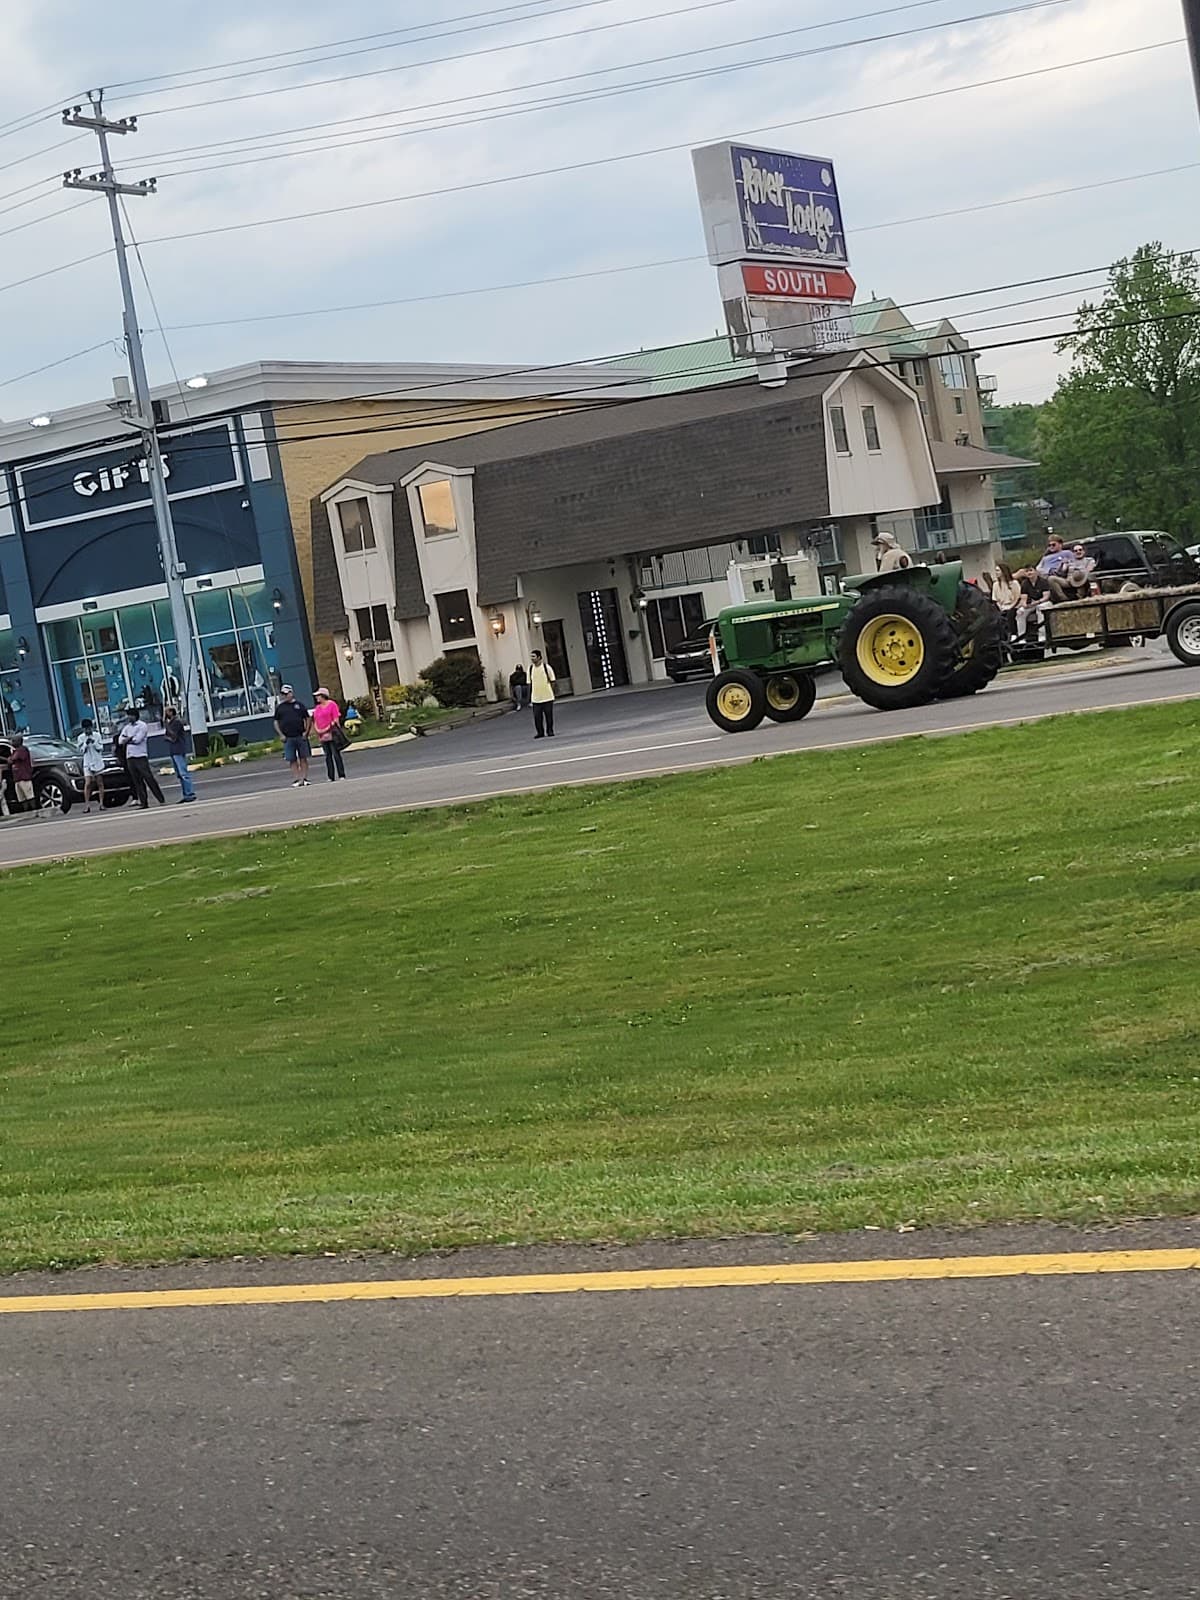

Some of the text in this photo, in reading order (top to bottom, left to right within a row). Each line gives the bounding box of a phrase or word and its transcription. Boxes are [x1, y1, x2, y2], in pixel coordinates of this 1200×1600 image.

[740, 156, 785, 207] River
[785, 191, 834, 252] Lodge
[763, 269, 827, 295] SOUTH
